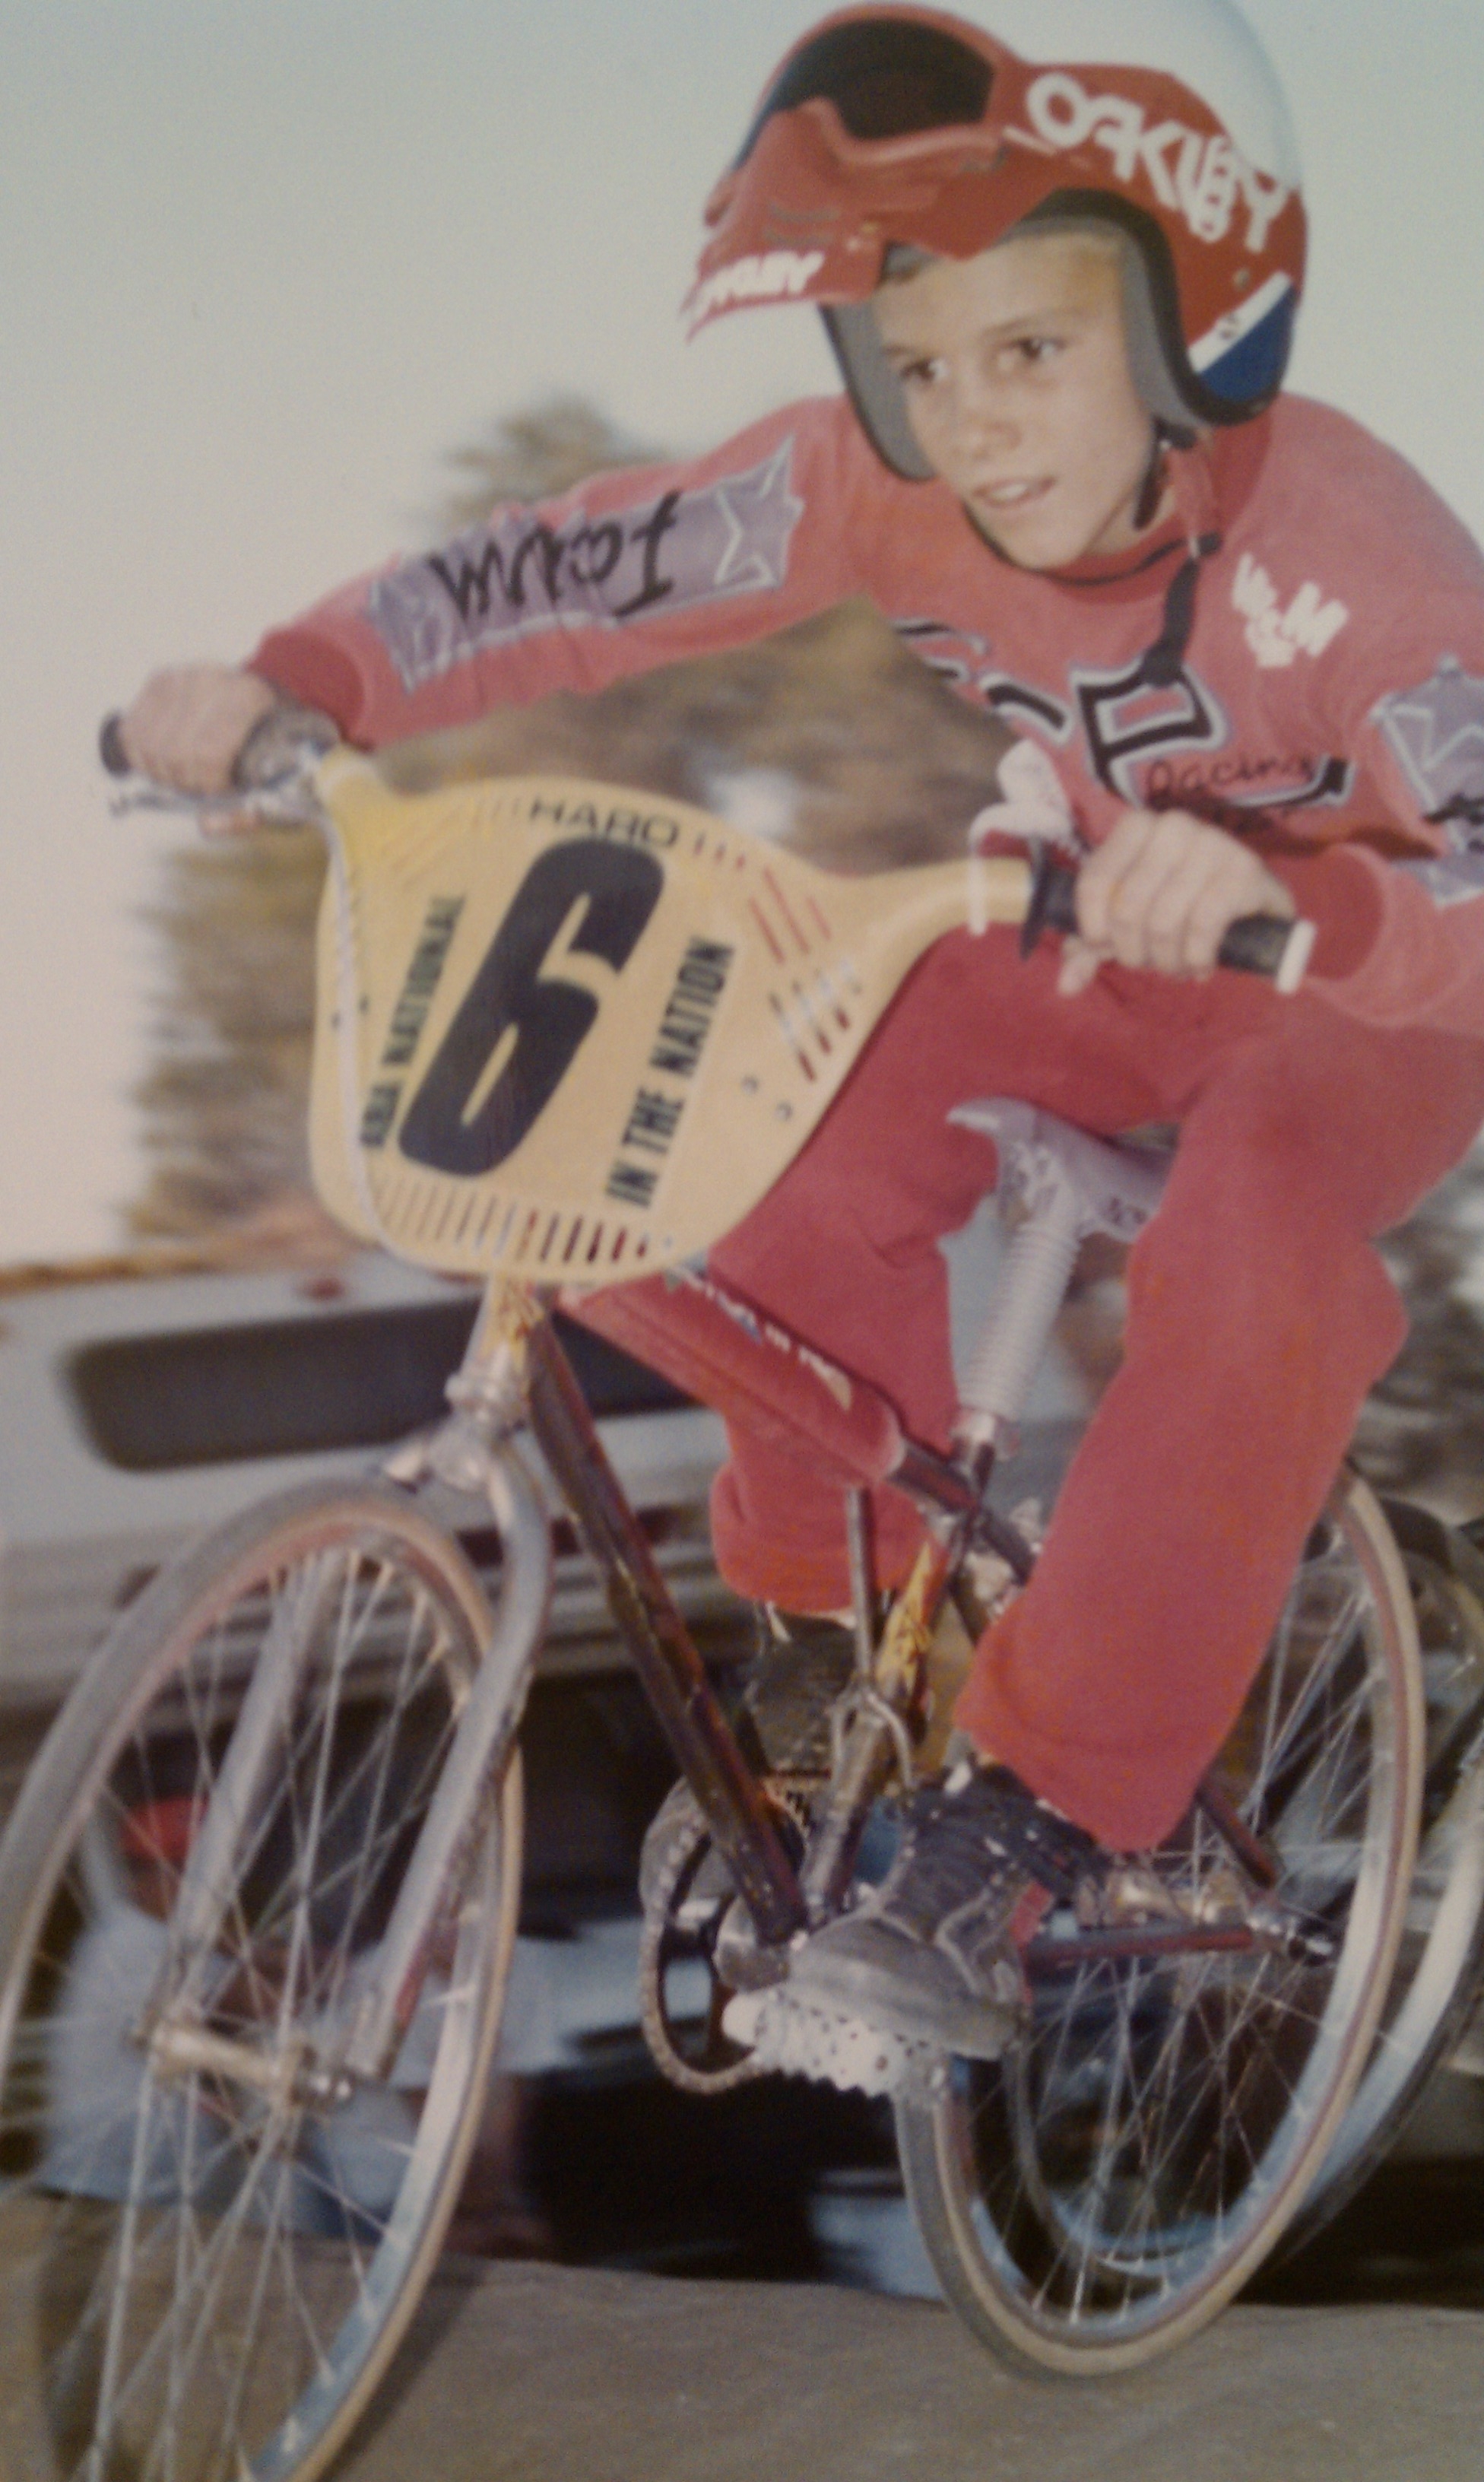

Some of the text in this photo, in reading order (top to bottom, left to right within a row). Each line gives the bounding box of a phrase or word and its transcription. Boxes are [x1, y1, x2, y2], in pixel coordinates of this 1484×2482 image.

[1026, 72, 1295, 254] OAKLEY
[529, 795, 680, 849] HARO
[398, 837, 666, 1177] 6
[606, 936, 734, 1208] IN THE NATION
